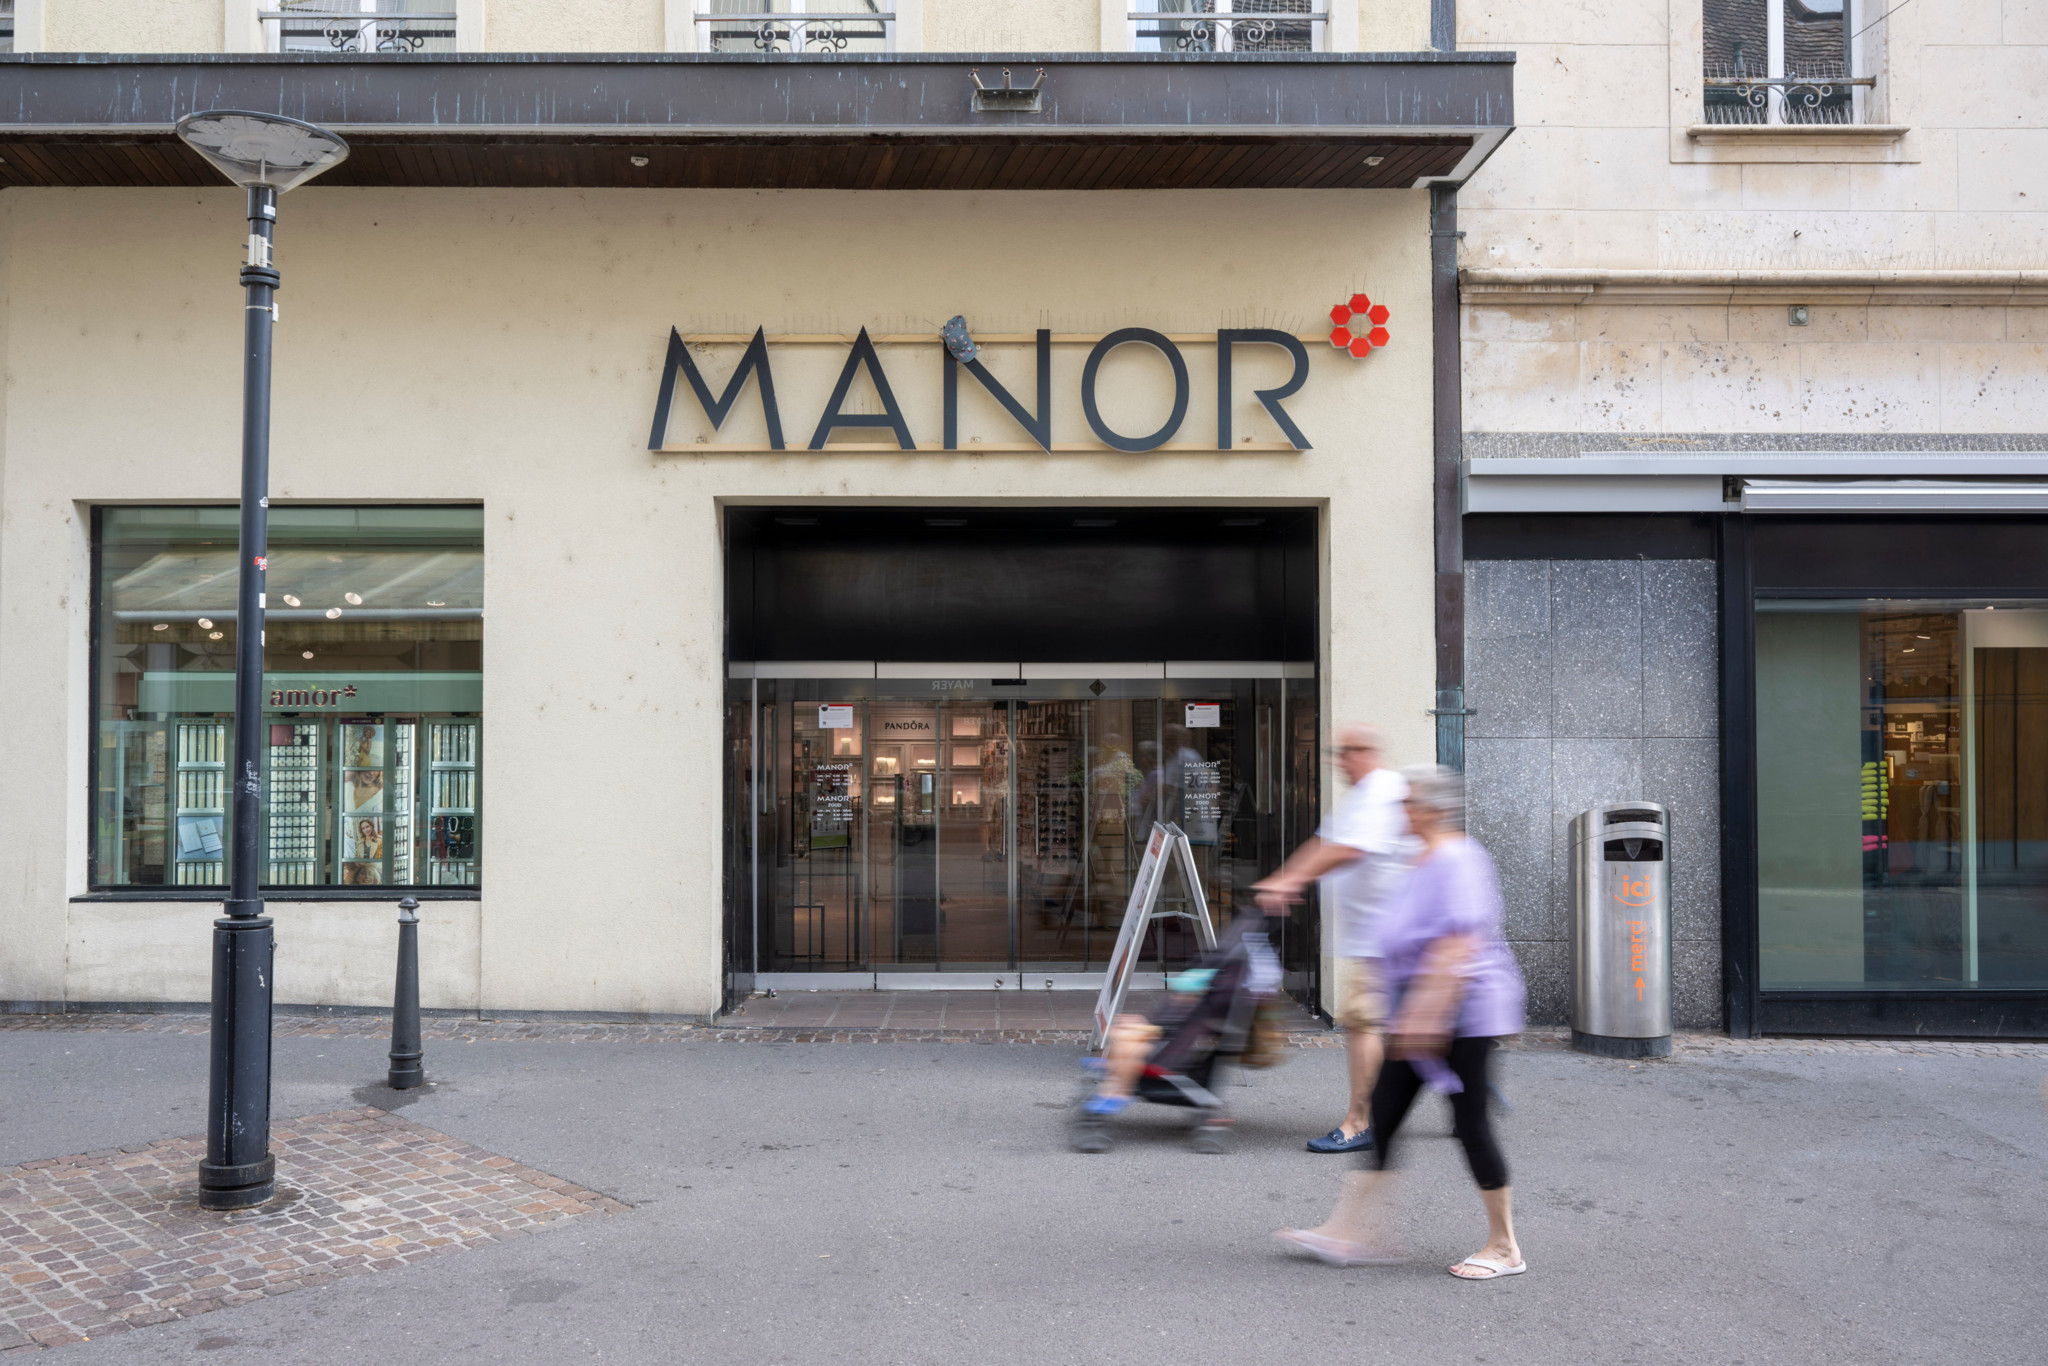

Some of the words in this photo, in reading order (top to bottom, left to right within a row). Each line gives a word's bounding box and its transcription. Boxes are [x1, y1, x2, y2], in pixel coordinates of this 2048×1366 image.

[647, 324, 1313, 455] MANOR
[1623, 875, 1650, 897] ici
[1626, 920, 1642, 972] merci
